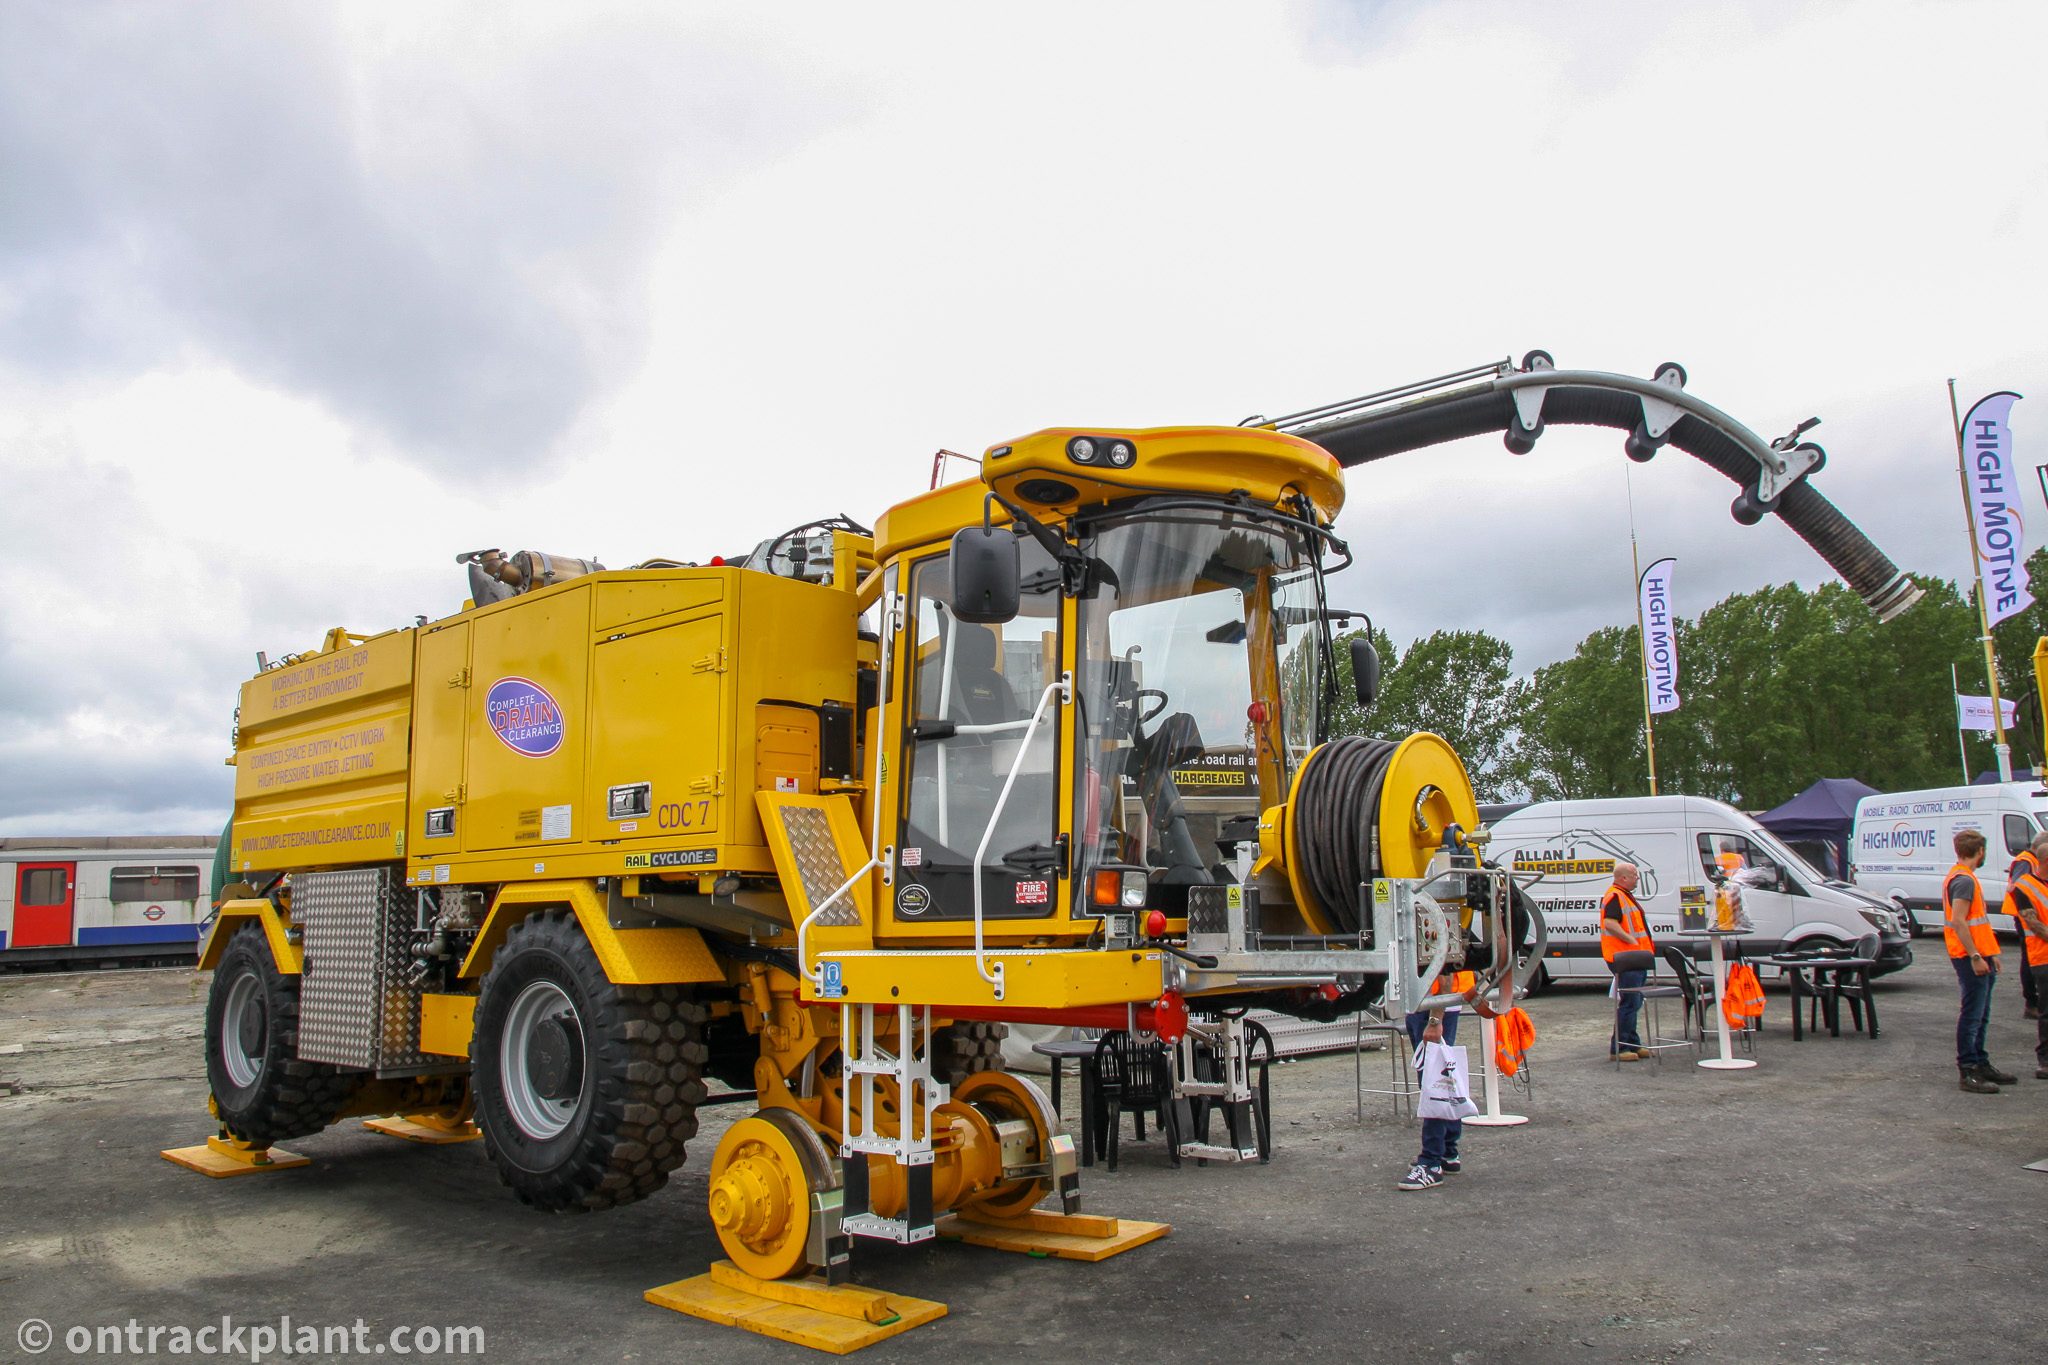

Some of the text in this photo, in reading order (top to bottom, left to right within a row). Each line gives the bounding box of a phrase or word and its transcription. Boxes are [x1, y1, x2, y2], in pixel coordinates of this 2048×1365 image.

[1974, 420, 2017, 613] HIGH MOTIVE
[1648, 578, 1673, 705] HIGH MOTIVE
[271, 650, 369, 692] WORKING ON THE RAIL FOR
[272, 672, 365, 711] A BETTER ENVIRONMENT
[489, 694, 536, 712] COMPLETE
[495, 701, 553, 732] DRAIN
[508, 723, 561, 742] CLEARANCE
[250, 726, 386, 770] CONFINED SPACE ENTRY CCTV WORK
[1228, 754, 1245, 766] rail
[258, 752, 375, 788] HIGH PRESSURE WATER JETTING
[1173, 771, 1244, 784] HARGREAVES
[658, 801, 710, 828] CDC 7
[1863, 800, 1972, 818] MOBILE RADIO CONTROL ROOM
[241, 821, 392, 852] WWW.COMPLETEDRAINCLEARANCE.CO.UK
[1862, 829, 1936, 849] HIGH MOTIVE
[625, 855, 649, 867] RAIL
[652, 850, 704, 866] CYCLONE
[1514, 847, 1576, 862] ALLAN J
[1514, 861, 1615, 875] HARGREAVES
[1022, 884, 1041, 893] FIRE
[1535, 898, 1596, 912] ngineers
